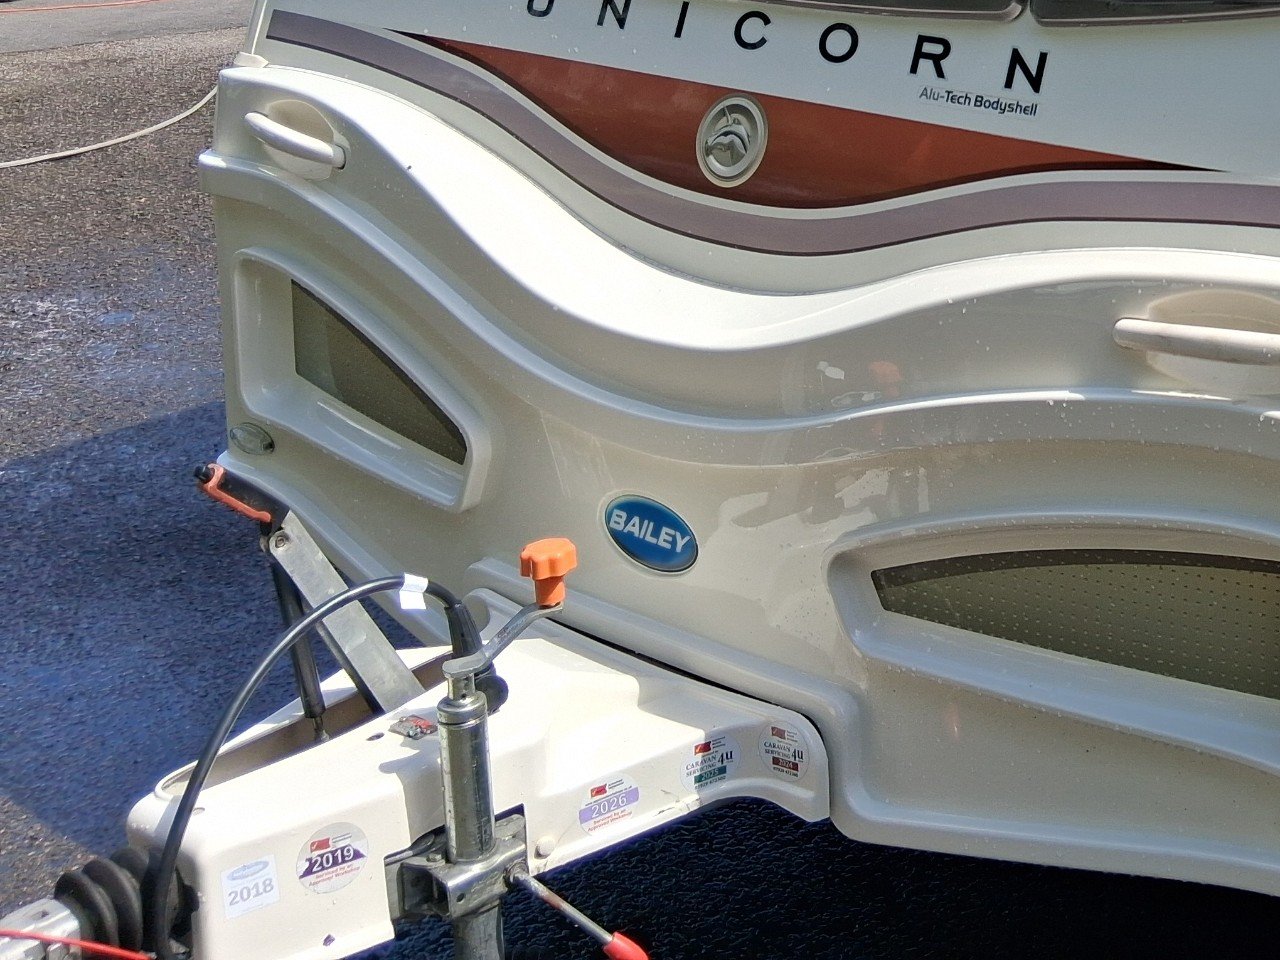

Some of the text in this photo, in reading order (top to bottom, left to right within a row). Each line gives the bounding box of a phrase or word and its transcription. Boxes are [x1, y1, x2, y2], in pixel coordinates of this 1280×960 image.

[919, 86, 1038, 117] Alu-Tech Bodyshell
[609, 508, 693, 553] BAILEY
[591, 793, 627, 819] 2026
[311, 845, 354, 873] 2019
[228, 878, 274, 906] 2018
